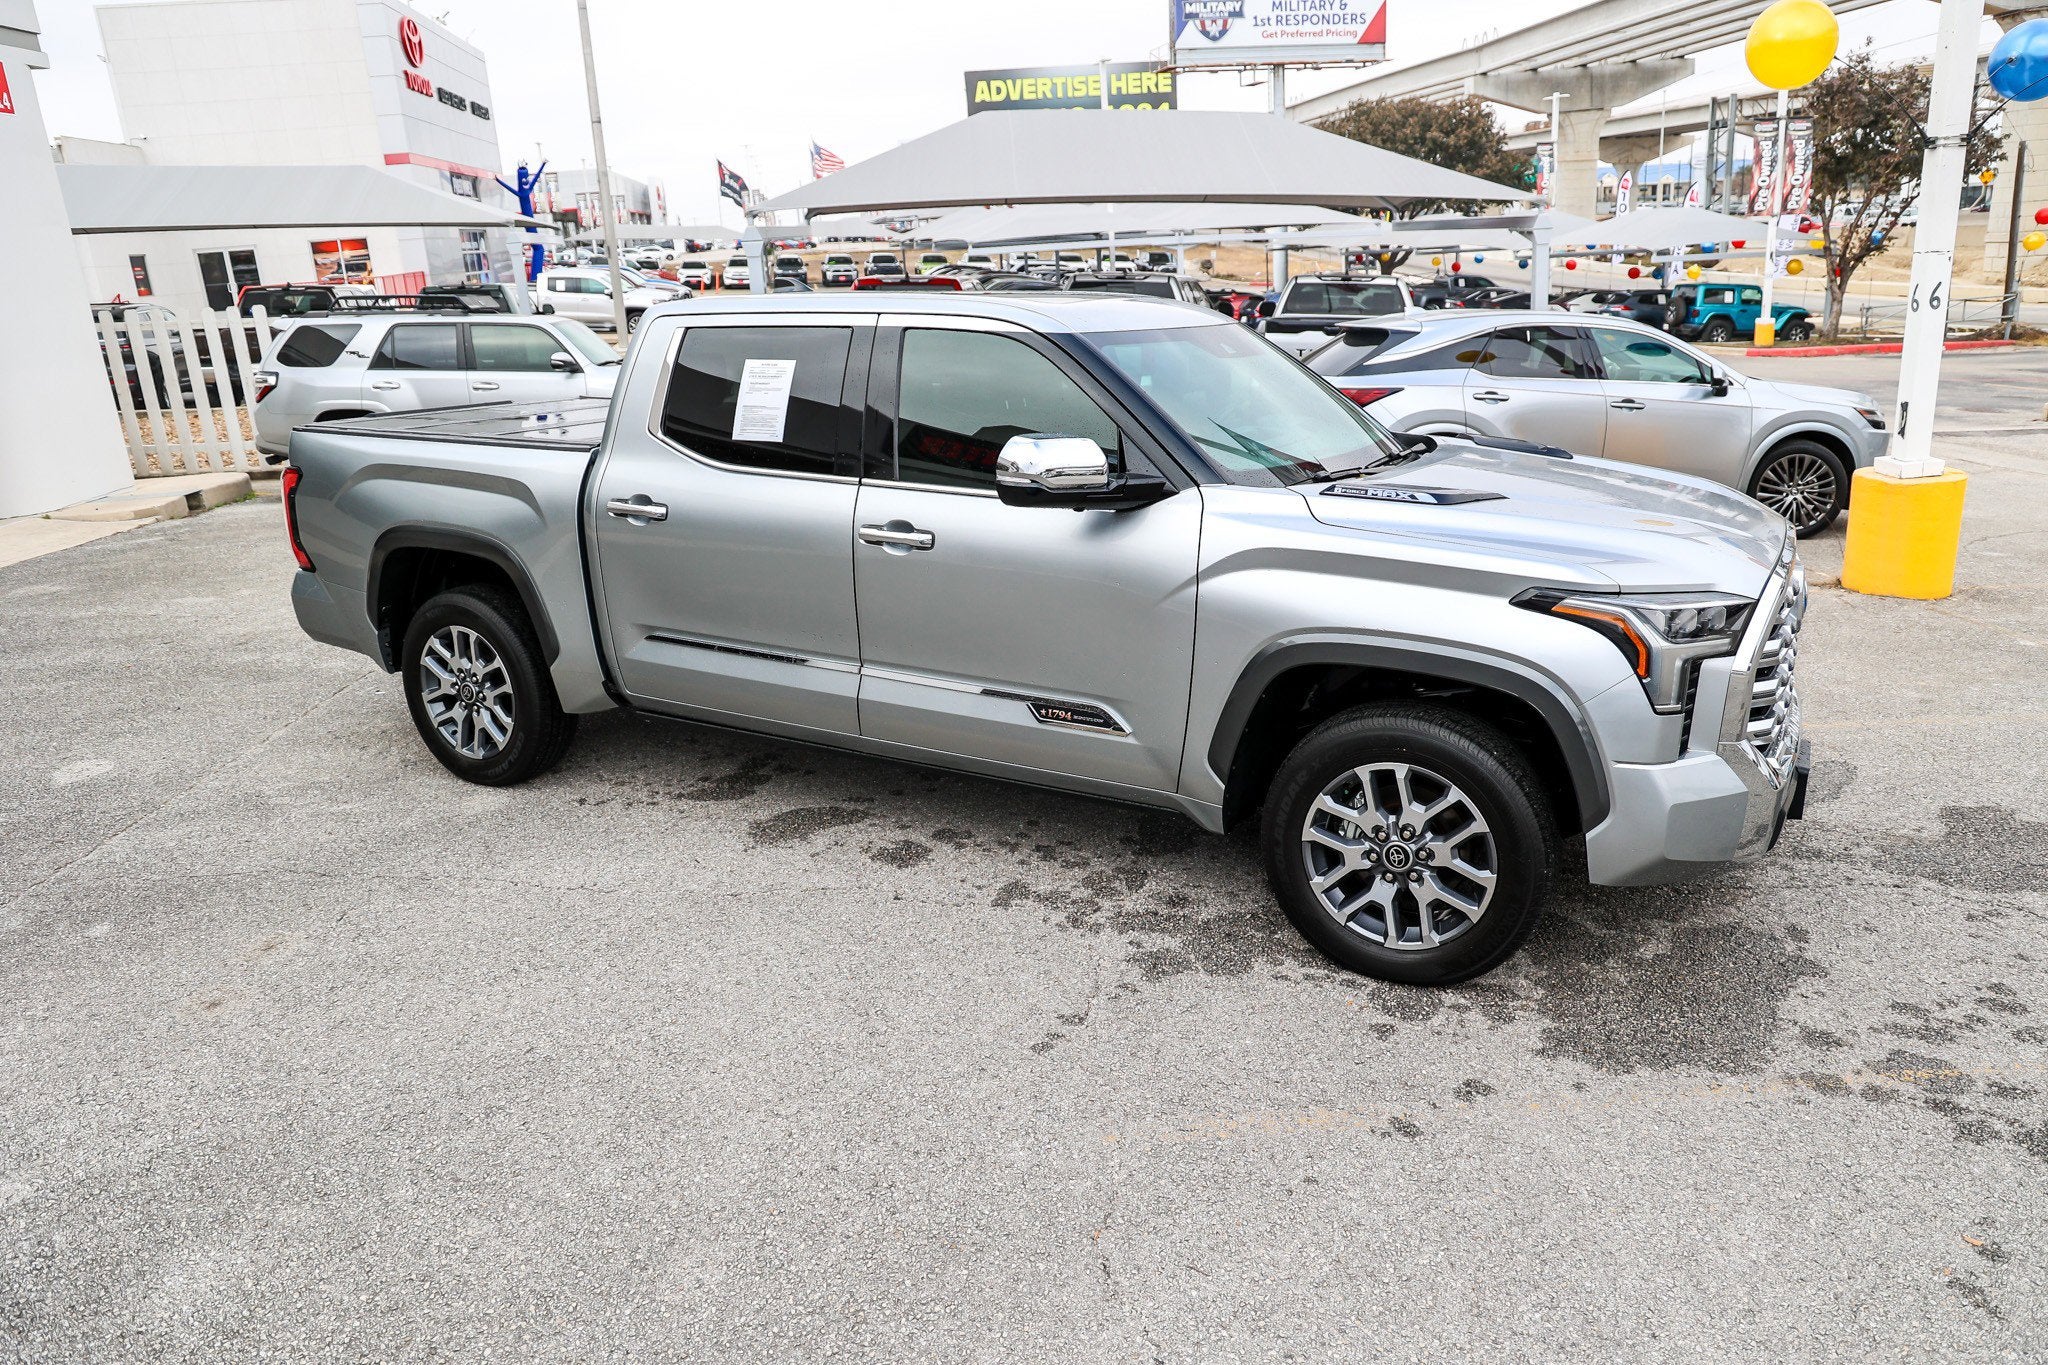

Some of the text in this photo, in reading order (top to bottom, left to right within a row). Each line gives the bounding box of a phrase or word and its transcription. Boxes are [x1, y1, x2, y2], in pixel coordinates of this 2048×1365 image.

[1185, 1, 1242, 14] MILITARY
[1271, 0, 1348, 12] MILITARY &
[1252, 13, 1366, 26] 1st RESPONDERS
[1262, 28, 1358, 39] Get Preferred Pricing
[974, 72, 1172, 103] ADVERTISE HERE
[1367, 488, 1412, 500] MAX
[1047, 709, 1072, 720] 1794
